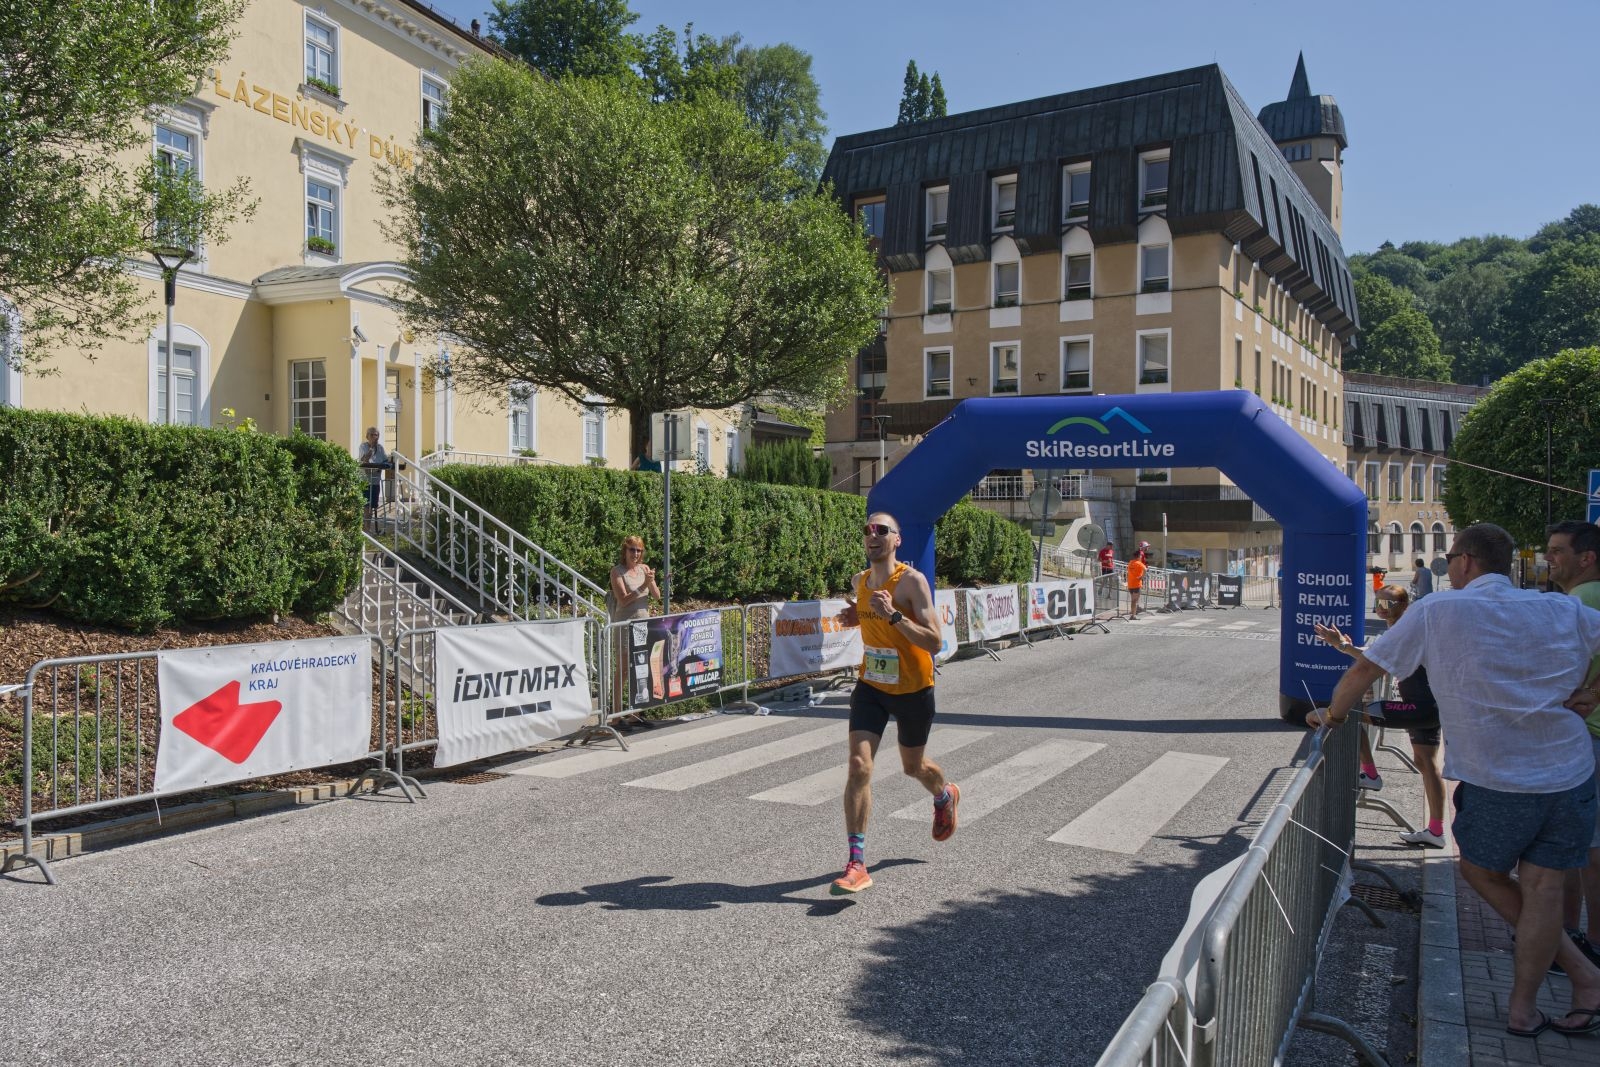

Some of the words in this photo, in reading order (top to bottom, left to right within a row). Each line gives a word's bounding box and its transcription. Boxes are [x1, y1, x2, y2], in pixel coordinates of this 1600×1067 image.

[214, 68, 360, 149] LÁZEŇSKÝ
[1026, 440, 1175, 457] SkiResortLive
[1297, 573, 1352, 586] SCHOOL
[1047, 583, 1092, 620] CÍL
[1298, 593, 1350, 607] RENTAL
[1296, 613, 1352, 627] SERVICE
[251, 653, 357, 675] KRÁLOVÉHRADECKÝ
[874, 658, 887, 670] 79
[249, 678, 278, 691] KRAJ
[1385, 702, 1416, 711] SILVA
